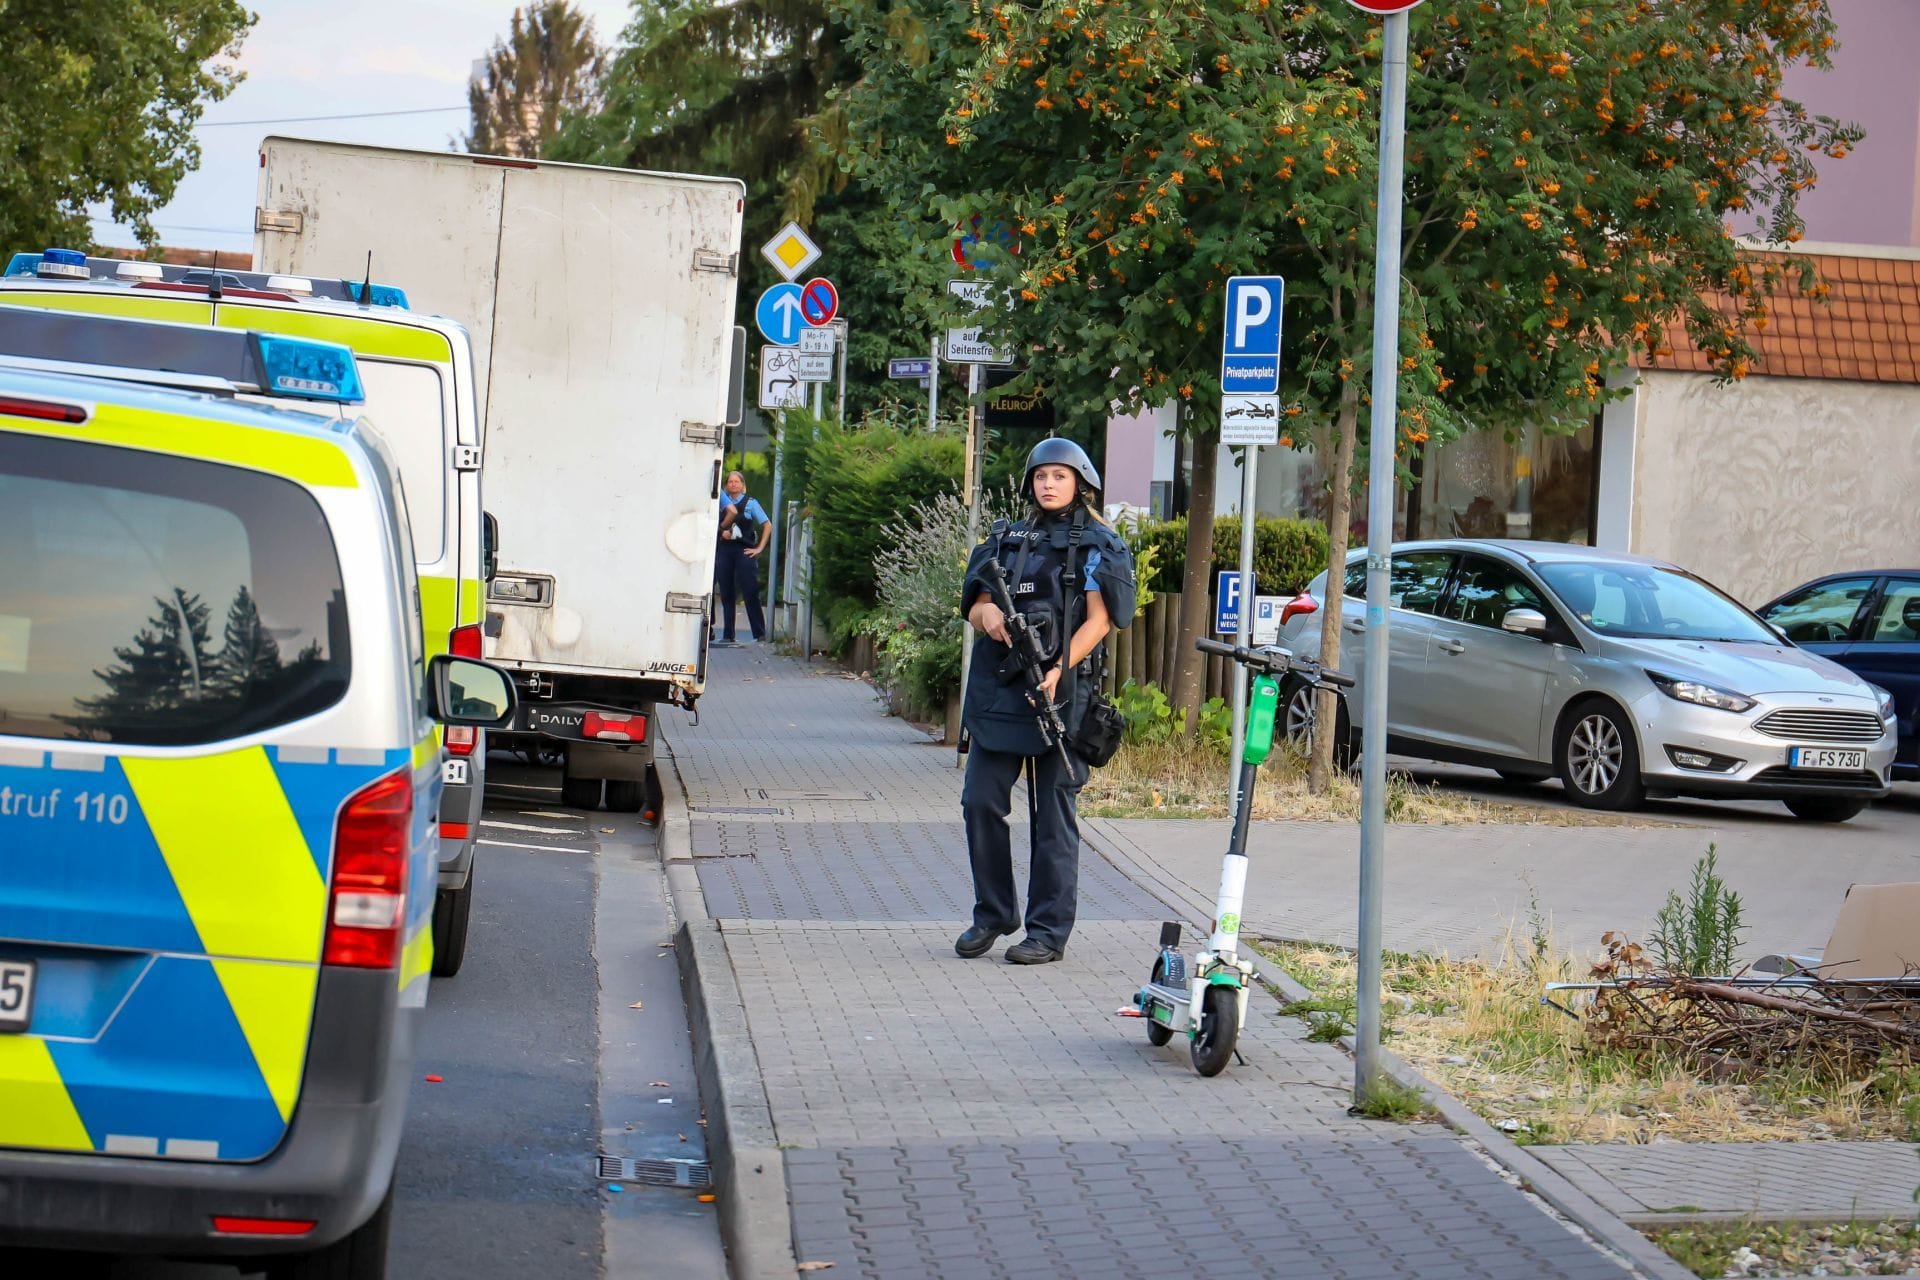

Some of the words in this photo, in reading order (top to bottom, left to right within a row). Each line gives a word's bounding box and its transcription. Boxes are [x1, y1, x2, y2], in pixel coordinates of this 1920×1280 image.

[1234, 285, 1272, 348] P
[962, 331, 977, 341] auf
[1226, 366, 1275, 379] Privatparkplatz
[990, 399, 1034, 411] FLEUROP
[1261, 603, 1270, 617] P
[648, 661, 686, 672] JUNGE
[540, 714, 583, 726] DAILY
[1803, 750, 1812, 766] F
[73, 791, 129, 825] 110
